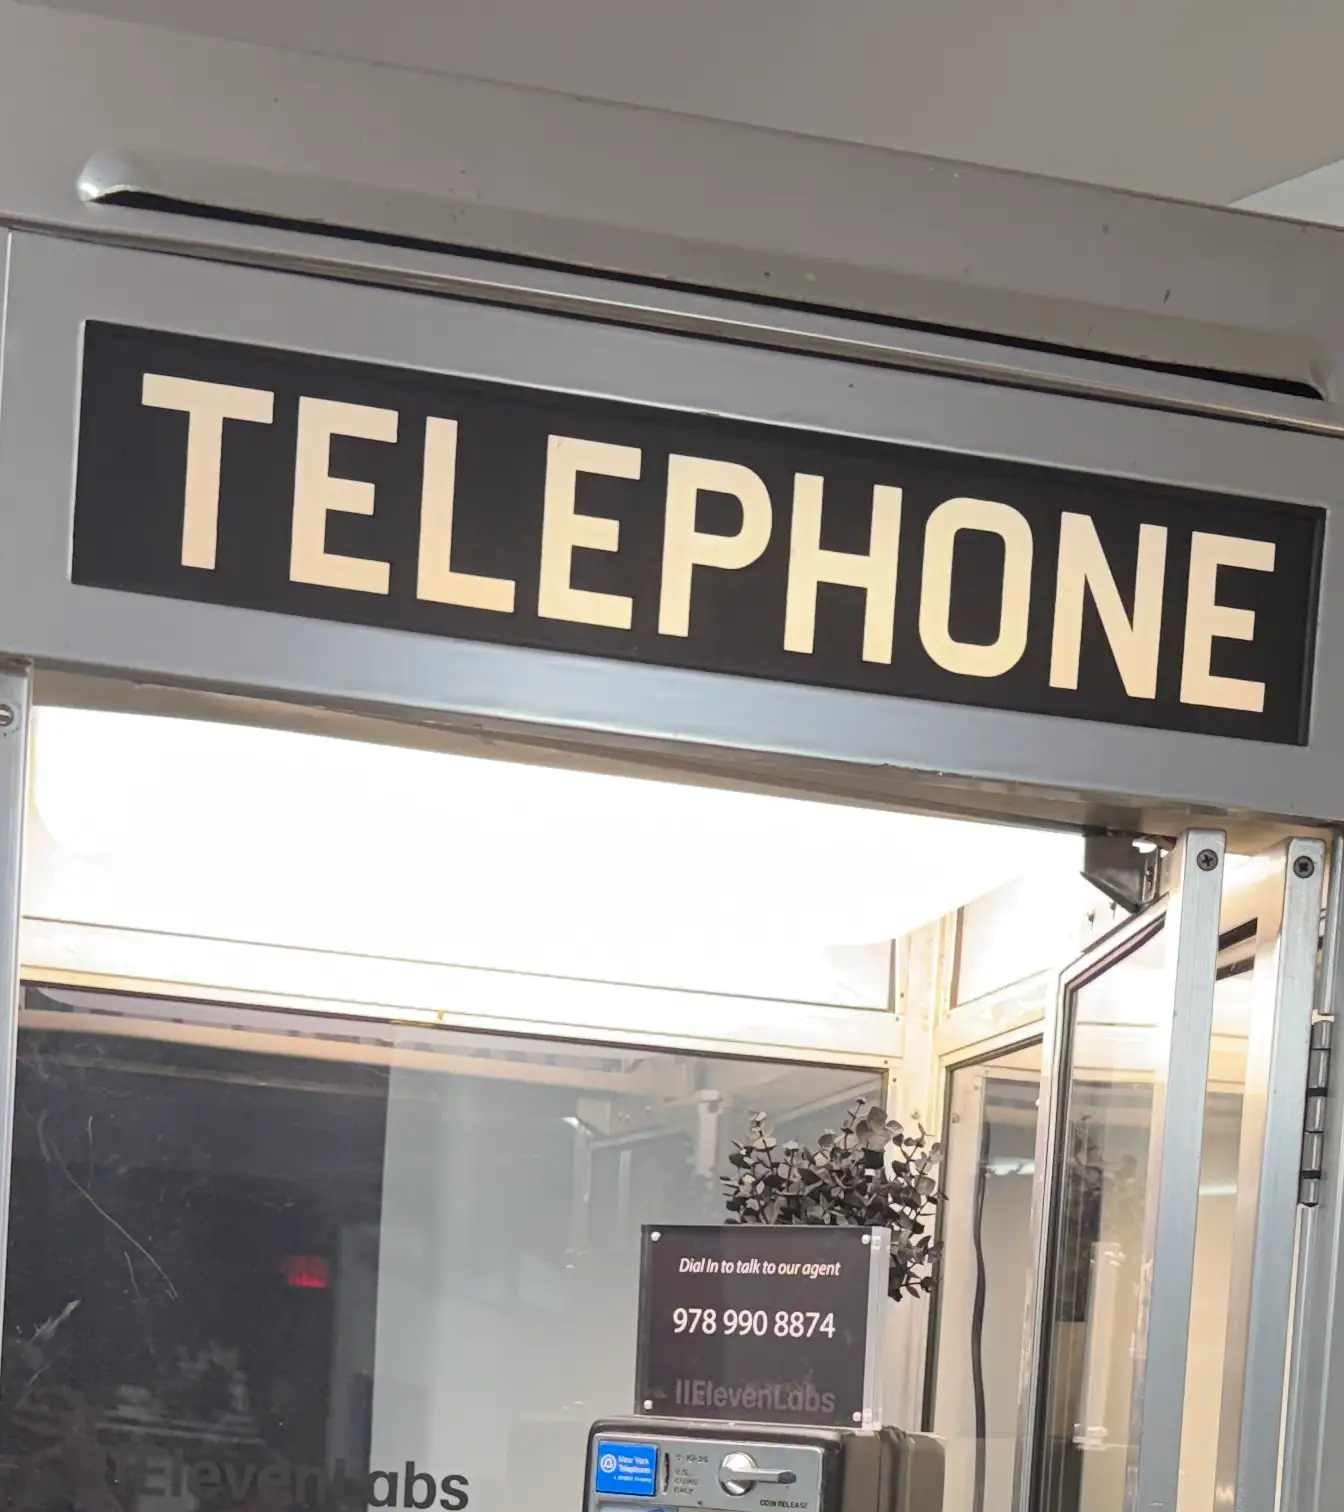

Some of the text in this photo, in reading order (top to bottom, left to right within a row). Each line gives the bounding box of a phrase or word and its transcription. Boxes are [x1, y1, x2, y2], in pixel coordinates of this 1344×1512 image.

[142, 373, 1277, 713] TELEPHONE
[679, 1257, 705, 1273] Dial
[721, 1259, 735, 1274] to
[736, 1258, 760, 1275] talk
[762, 1260, 776, 1275] to
[777, 1262, 801, 1276] our
[801, 1261, 841, 1279] agent
[673, 1308, 836, 1338] 978 990 8874
